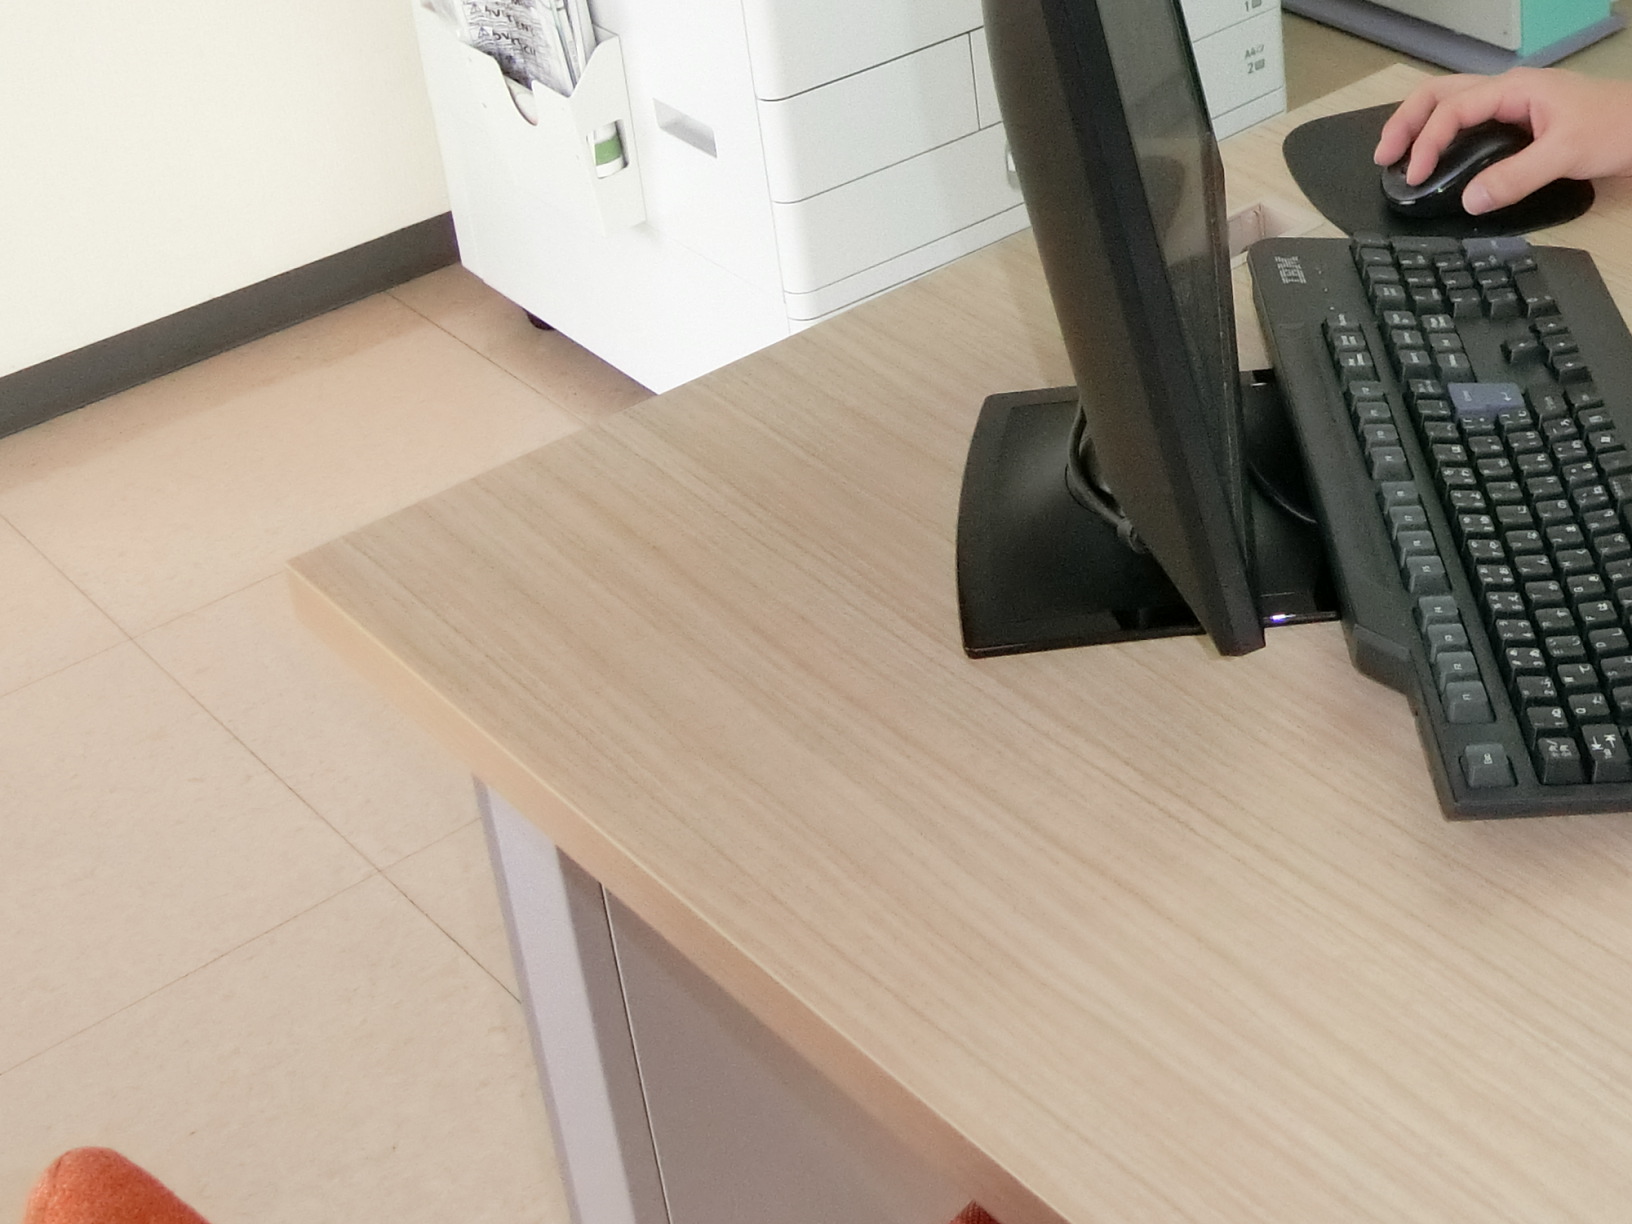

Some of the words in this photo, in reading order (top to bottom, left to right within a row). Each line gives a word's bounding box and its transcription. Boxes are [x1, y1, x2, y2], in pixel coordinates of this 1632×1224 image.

[1248, 62, 1254, 74] 2
[1274, 256, 1306, 283] IBM
[1578, 664, 1590, 674] て
[1592, 696, 1604, 705] た
[1483, 752, 1493, 765] Esc
